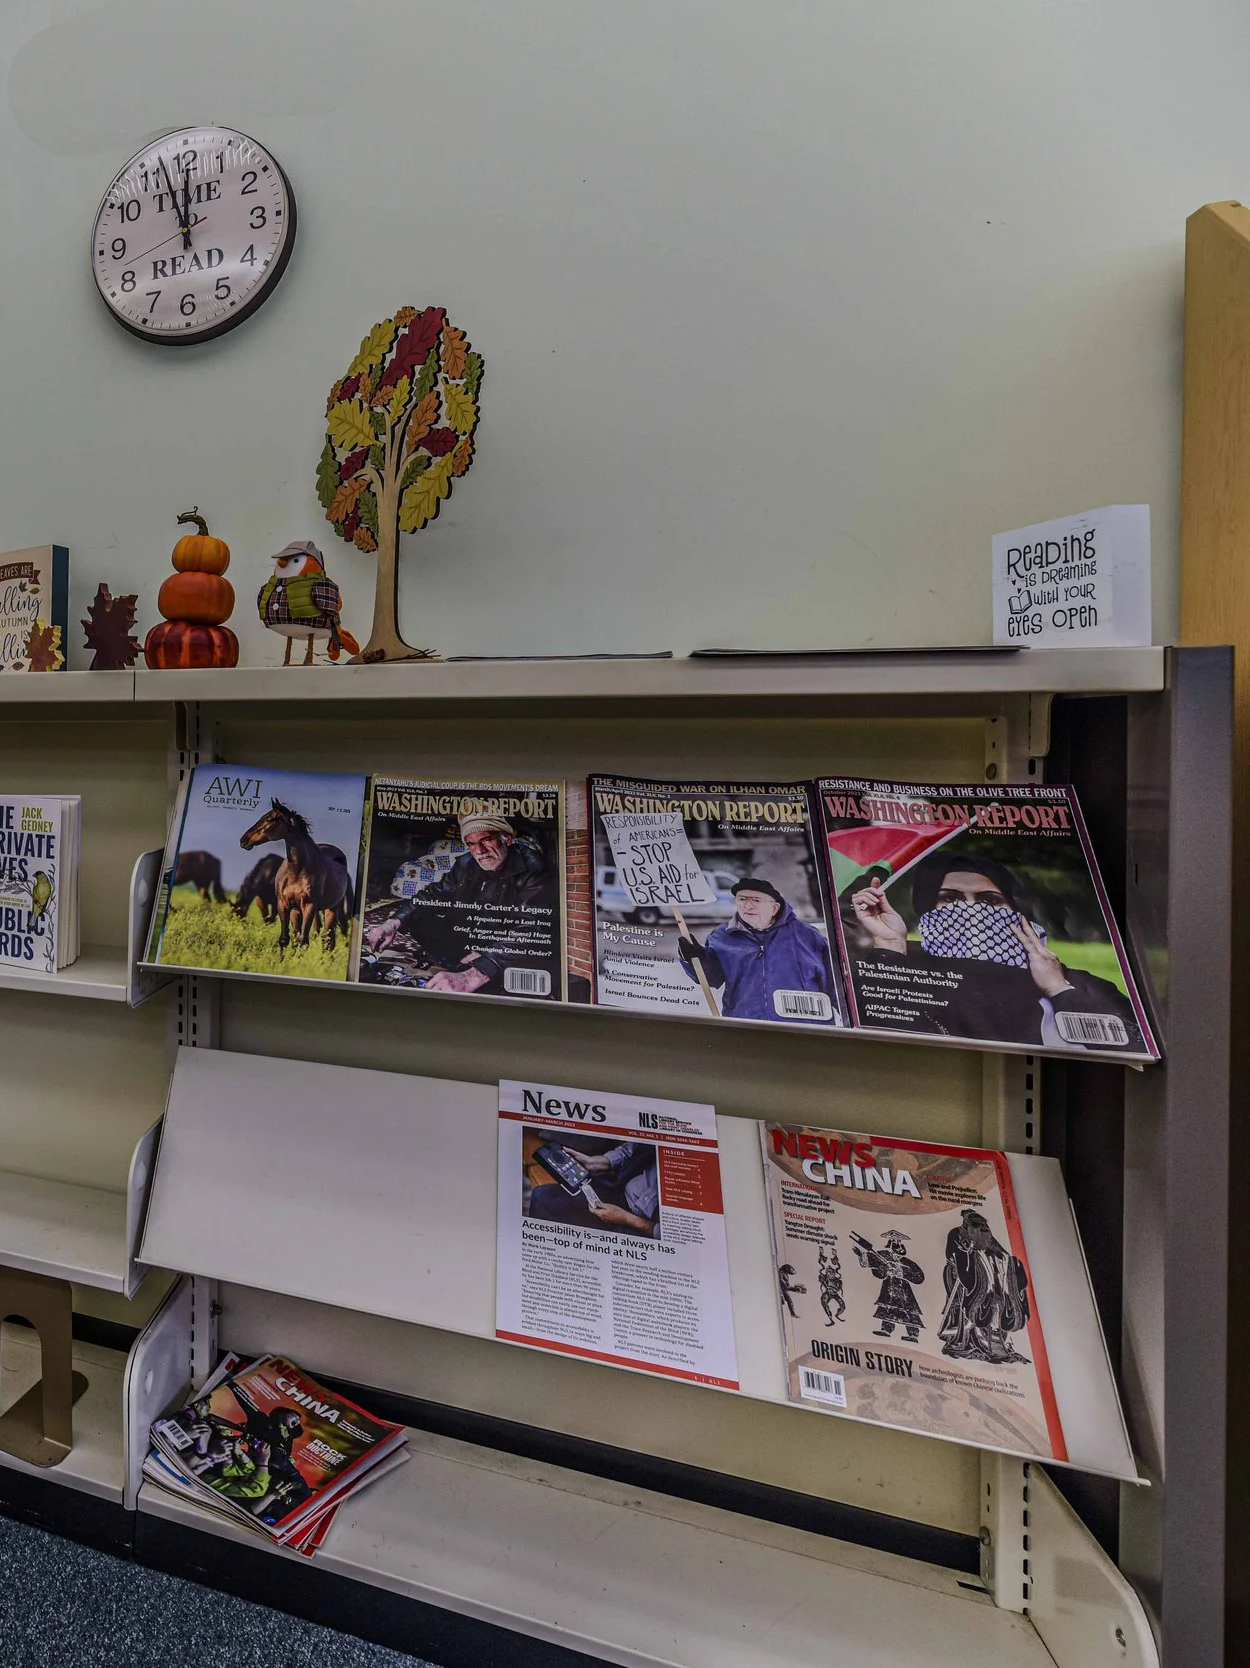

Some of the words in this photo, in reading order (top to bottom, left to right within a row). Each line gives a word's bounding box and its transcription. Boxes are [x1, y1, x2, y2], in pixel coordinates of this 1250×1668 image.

[141, 167, 160, 192] 11
[216, 151, 224, 173] 1
[173, 149, 198, 174] 12
[241, 171, 258, 195] 2
[153, 180, 222, 213] TIME
[117, 199, 141, 223] 10
[249, 206, 267, 229] 3
[111, 238, 127, 260] 9
[240, 244, 258, 266] 4
[151, 247, 224, 280] READ
[120, 270, 137, 292] 8
[146, 290, 162, 314] 7
[179, 293, 196, 316] 6
[215, 276, 231, 300] 5
[20, 564, 32, 576] ARE
[20, 630, 28, 639] IS
[205, 776, 263, 799] AWI
[536, 784, 559, 792] DREAM
[592, 778, 613, 786] THE
[616, 780, 676, 792] MISGUIDED
[710, 785, 726, 793] ON
[769, 786, 806, 794] OMAR
[819, 780, 871, 791] RESISTANCE
[873, 783, 891, 792] AND
[893, 785, 938, 796] BUSINESS
[939, 787, 953, 796] ON
[955, 787, 974, 796] THE
[976, 787, 1005, 797] OLIVE
[1006, 788, 1031, 797] TREE
[1034, 788, 1066, 798] FRONT
[203, 795, 260, 808] Quarterly
[376, 791, 484, 816] WASHINGTON
[485, 797, 556, 819] REPORT
[724, 800, 806, 823] REPORT
[824, 796, 971, 827] WASHINGTON
[973, 804, 1071, 828] REPORT
[22, 807, 42, 819] JACK
[604, 814, 678, 829] RESPONSIBILITY
[21, 820, 53, 833] GEDNEY
[613, 833, 621, 844] of
[631, 842, 672, 865] STOP
[623, 867, 655, 887] U.S.
[658, 864, 681, 884] AID
[684, 864, 699, 880] for
[629, 884, 705, 905] ISRAEL
[412, 898, 452, 907] President
[454, 901, 482, 911] Jimmy
[484, 903, 519, 912] Carter's
[521, 906, 552, 915] Legacy
[602, 922, 651, 936] Palestine
[654, 929, 664, 937] is
[603, 932, 619, 943] My
[622, 935, 656, 946] Cause
[856, 960, 875, 969] The
[877, 963, 928, 976] Resistance
[858, 969, 910, 982] Palestinian
[912, 975, 958, 989] Authority
[605, 988, 625, 997] Israel
[627, 992, 658, 1001] Bounces
[660, 996, 680, 1004] Dead
[865, 1004, 890, 1012] AIPAC
[892, 1007, 920, 1016] Targets
[866, 1011, 914, 1021] Progressives
[522, 1089, 606, 1122] News
[639, 1112, 658, 1129] NLS
[771, 1129, 875, 1168] NEWS
[802, 1158, 922, 1199] CHINA
[784, 1211, 804, 1221] SPECIAL
[805, 1215, 826, 1225] REPORT
[522, 1220, 581, 1238] Accessibility
[620, 1238, 655, 1251] always
[657, 1243, 675, 1255] has
[573, 1240, 583, 1249] of
[585, 1243, 610, 1255] mind
[626, 1250, 647, 1261] NLS
[811, 1339, 862, 1367] ORIGIN
[865, 1352, 914, 1378] STORY
[275, 1377, 340, 1423] CHINA
[313, 1439, 347, 1460] ROCK
